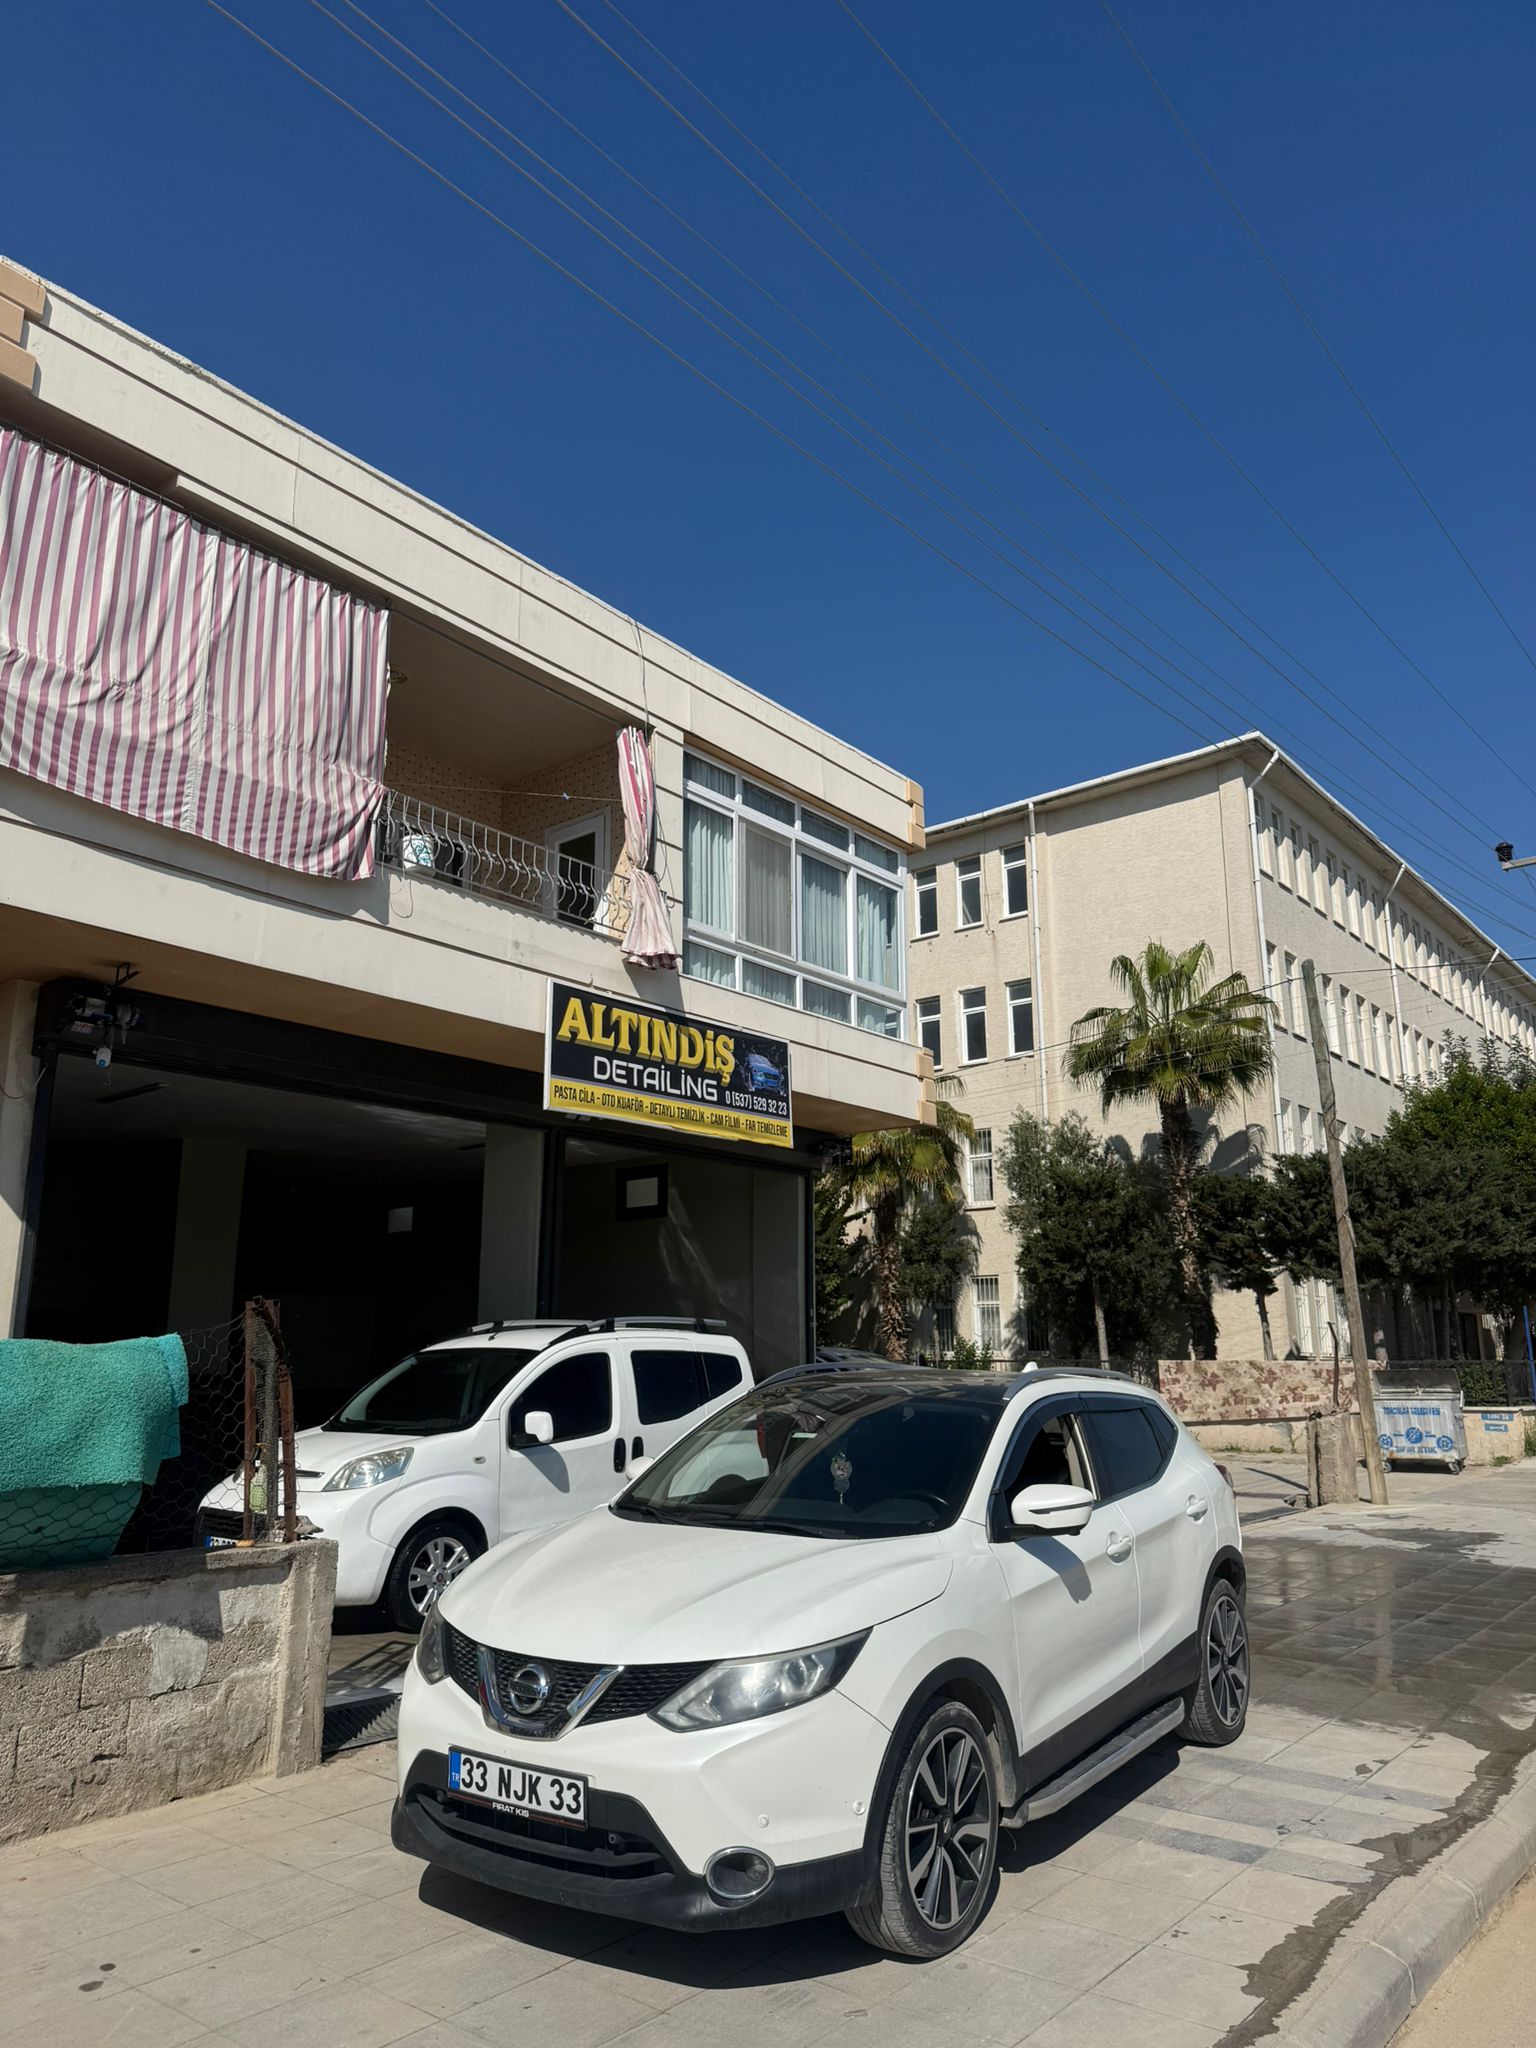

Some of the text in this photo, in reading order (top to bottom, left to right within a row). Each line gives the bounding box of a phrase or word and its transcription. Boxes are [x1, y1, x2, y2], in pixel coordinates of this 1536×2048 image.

[554, 1085, 577, 1101] PASTA
[579, 1087, 595, 1104] CİLA
[601, 1093, 616, 1107] OTO
[617, 1096, 644, 1113] KUAFÖR
[649, 1102, 675, 1118] DETAYLI
[677, 1106, 705, 1123] TEMİZLİK
[710, 1112, 724, 1126] CAM
[724, 1113, 741, 1129] FİLMİ
[745, 1119, 757, 1132] FAR
[757, 1120, 788, 1137] TEMİZLEME
[732, 1091, 752, 1109] (537)
[753, 1096, 767, 1111] 529
[768, 1099, 777, 1114] 32
[778, 1101, 787, 1115] 23
[452, 1757, 582, 1814] TR 33 NJK 33
[492, 1801, 515, 1814] FIRAT
